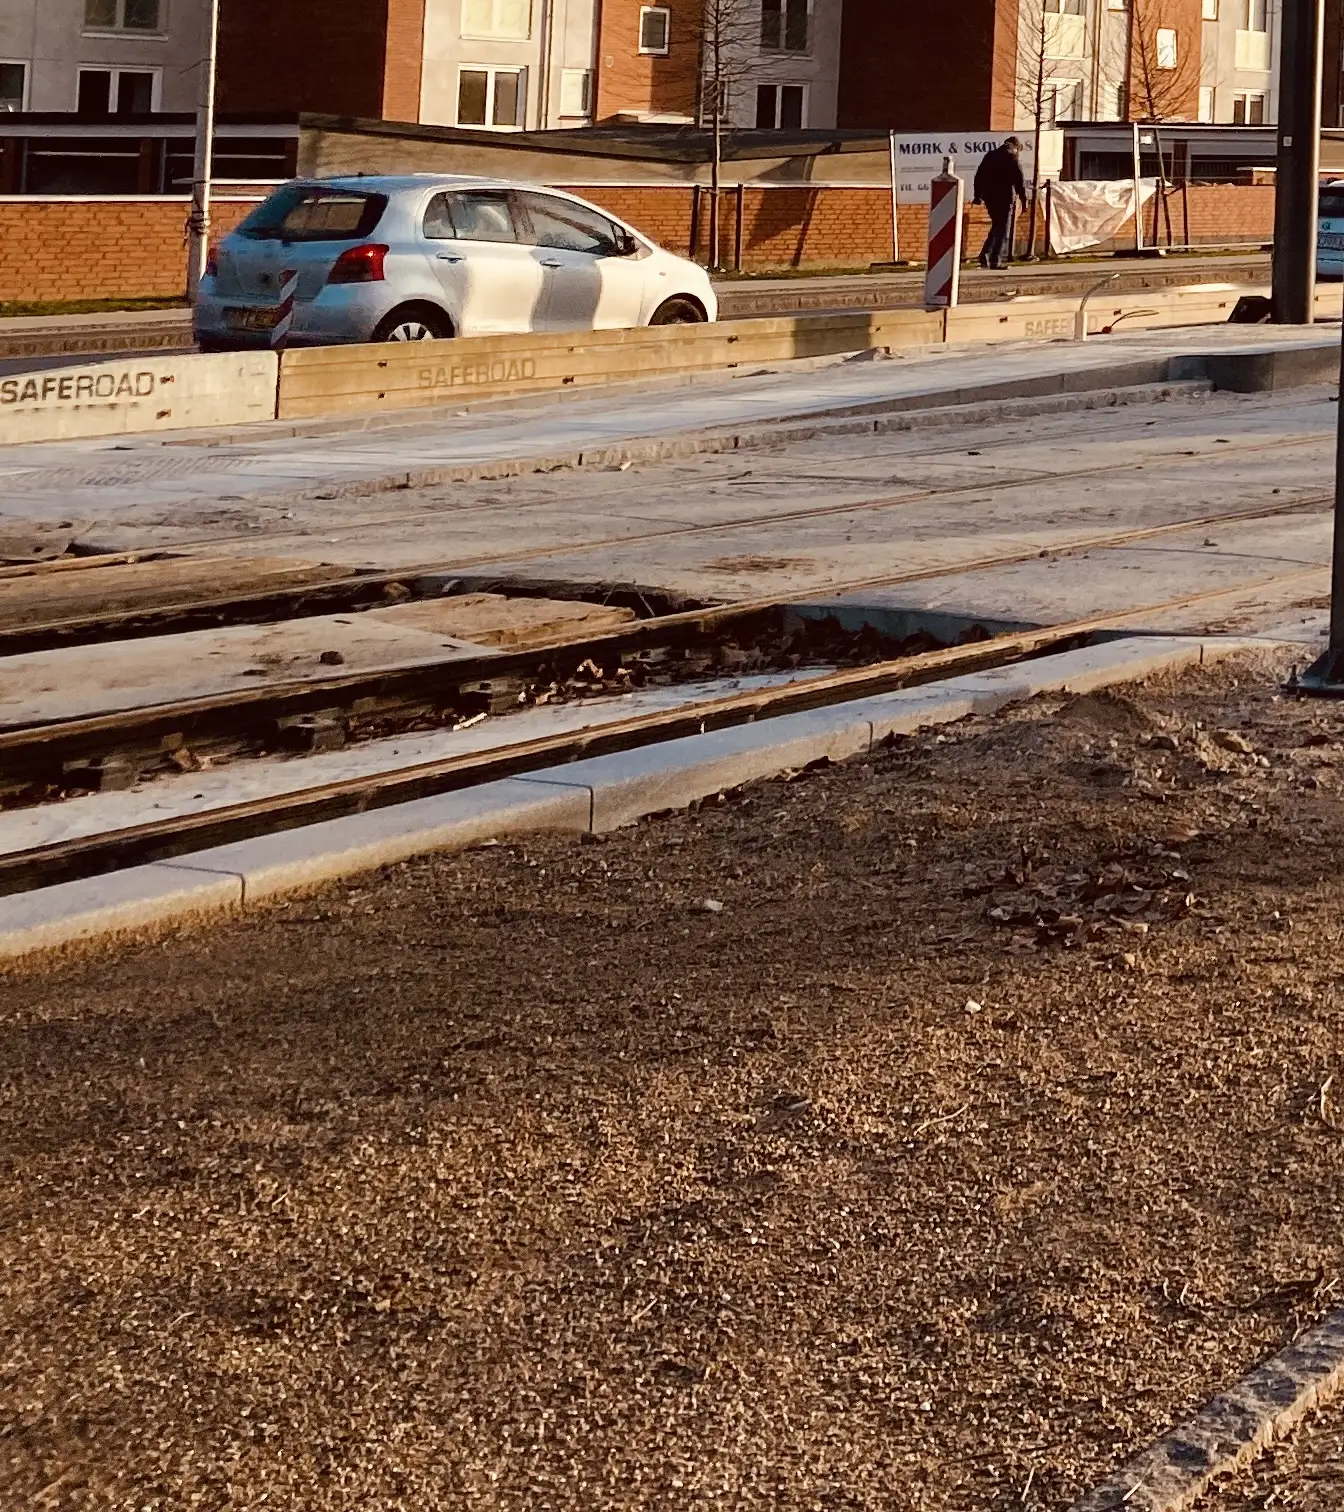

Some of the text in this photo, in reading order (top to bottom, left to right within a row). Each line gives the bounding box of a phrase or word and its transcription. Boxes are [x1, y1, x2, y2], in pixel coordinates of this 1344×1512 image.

[900, 143, 942, 155] MØRK
[948, 141, 958, 154] &
[0, 372, 155, 405] SAFEROAD
